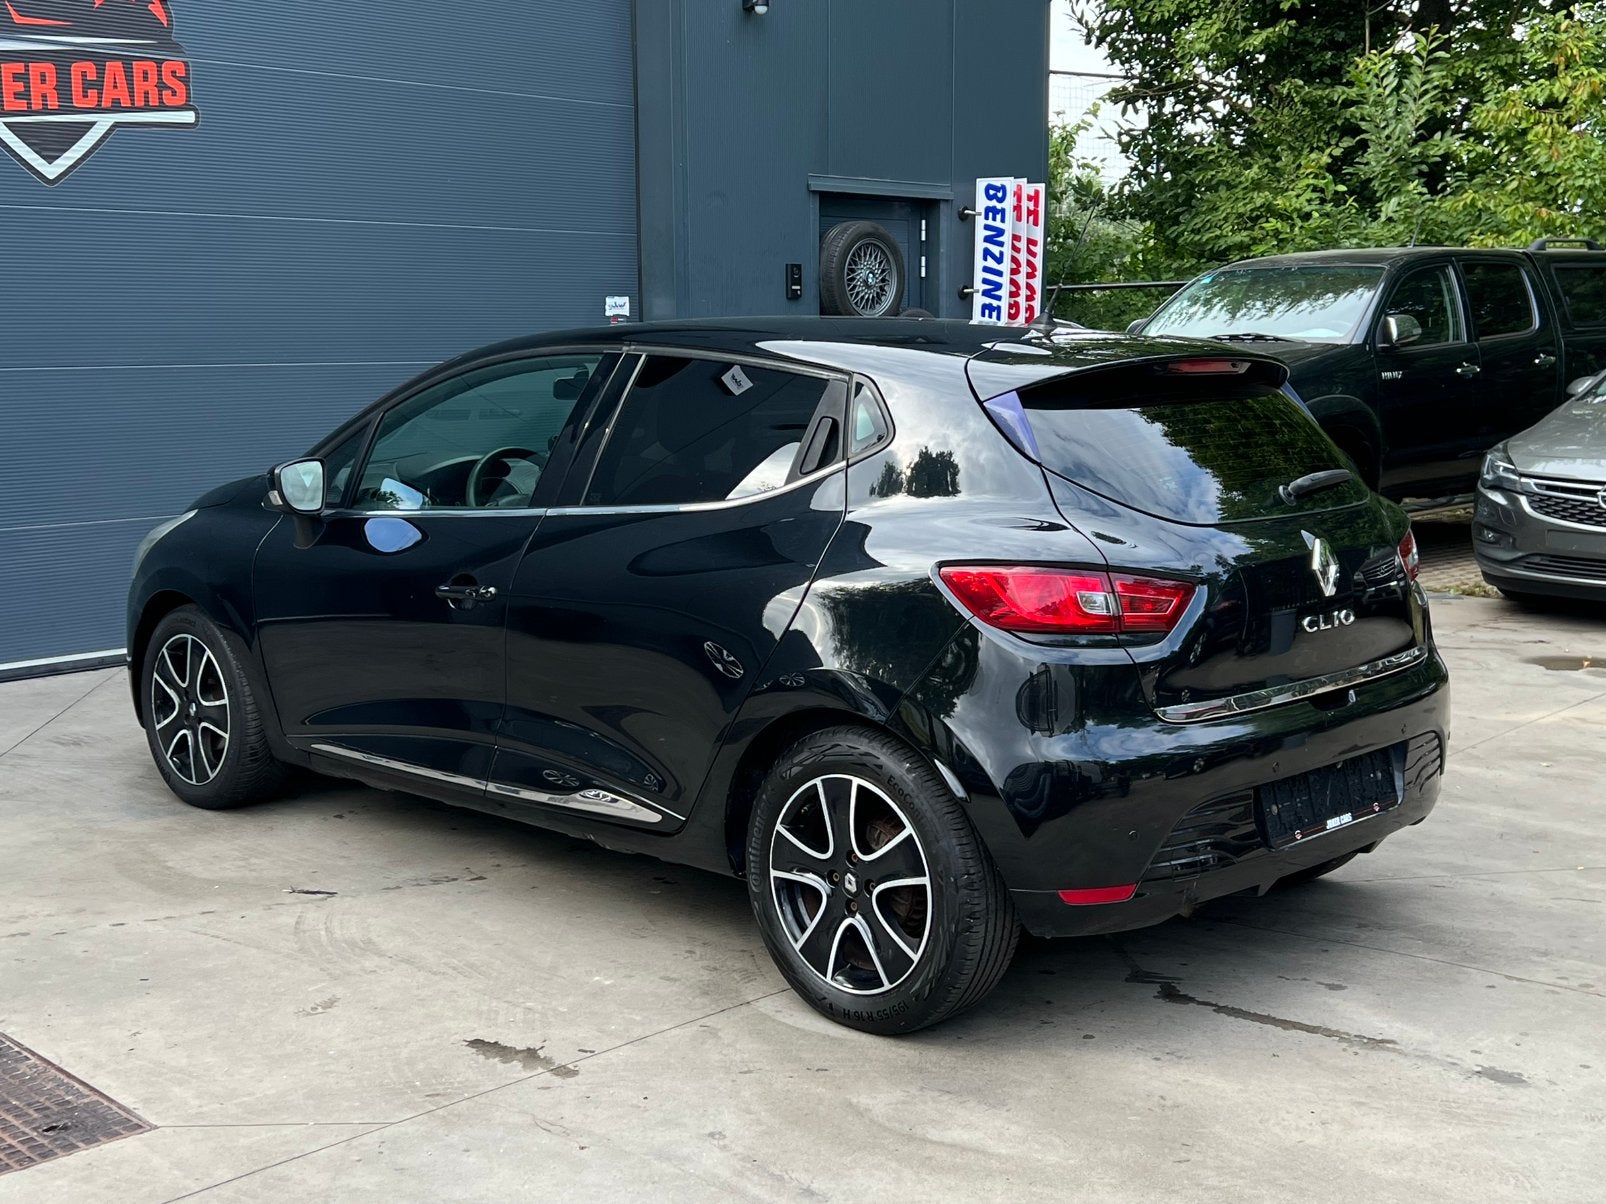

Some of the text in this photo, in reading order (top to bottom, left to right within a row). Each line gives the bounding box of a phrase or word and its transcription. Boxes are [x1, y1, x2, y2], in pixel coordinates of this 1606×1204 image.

[71, 60, 187, 109] CARS
[980, 183, 1007, 322] BENZINE
[1302, 609, 1355, 633] CLIO
